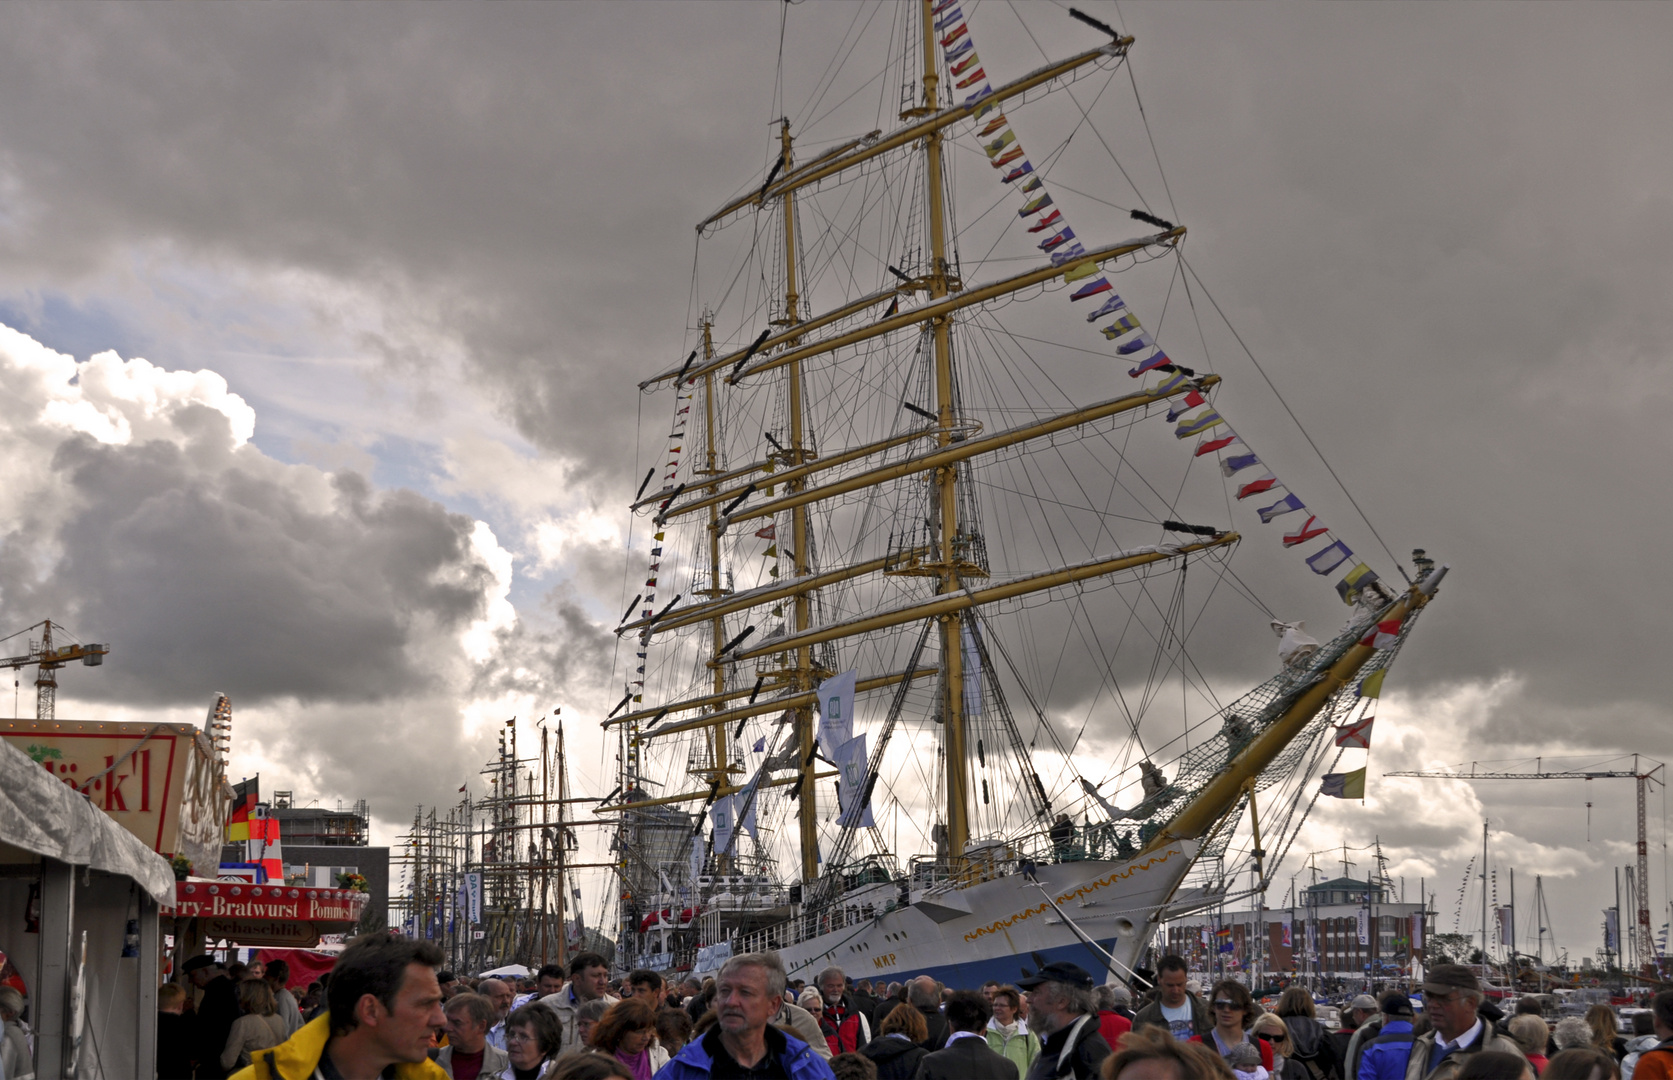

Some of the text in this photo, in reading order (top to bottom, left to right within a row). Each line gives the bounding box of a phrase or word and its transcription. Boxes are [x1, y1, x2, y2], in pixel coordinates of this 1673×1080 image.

[44, 748, 151, 812] öck'l
[310, 900, 349, 919] Pommes
[212, 920, 302, 937] Schaschlik
